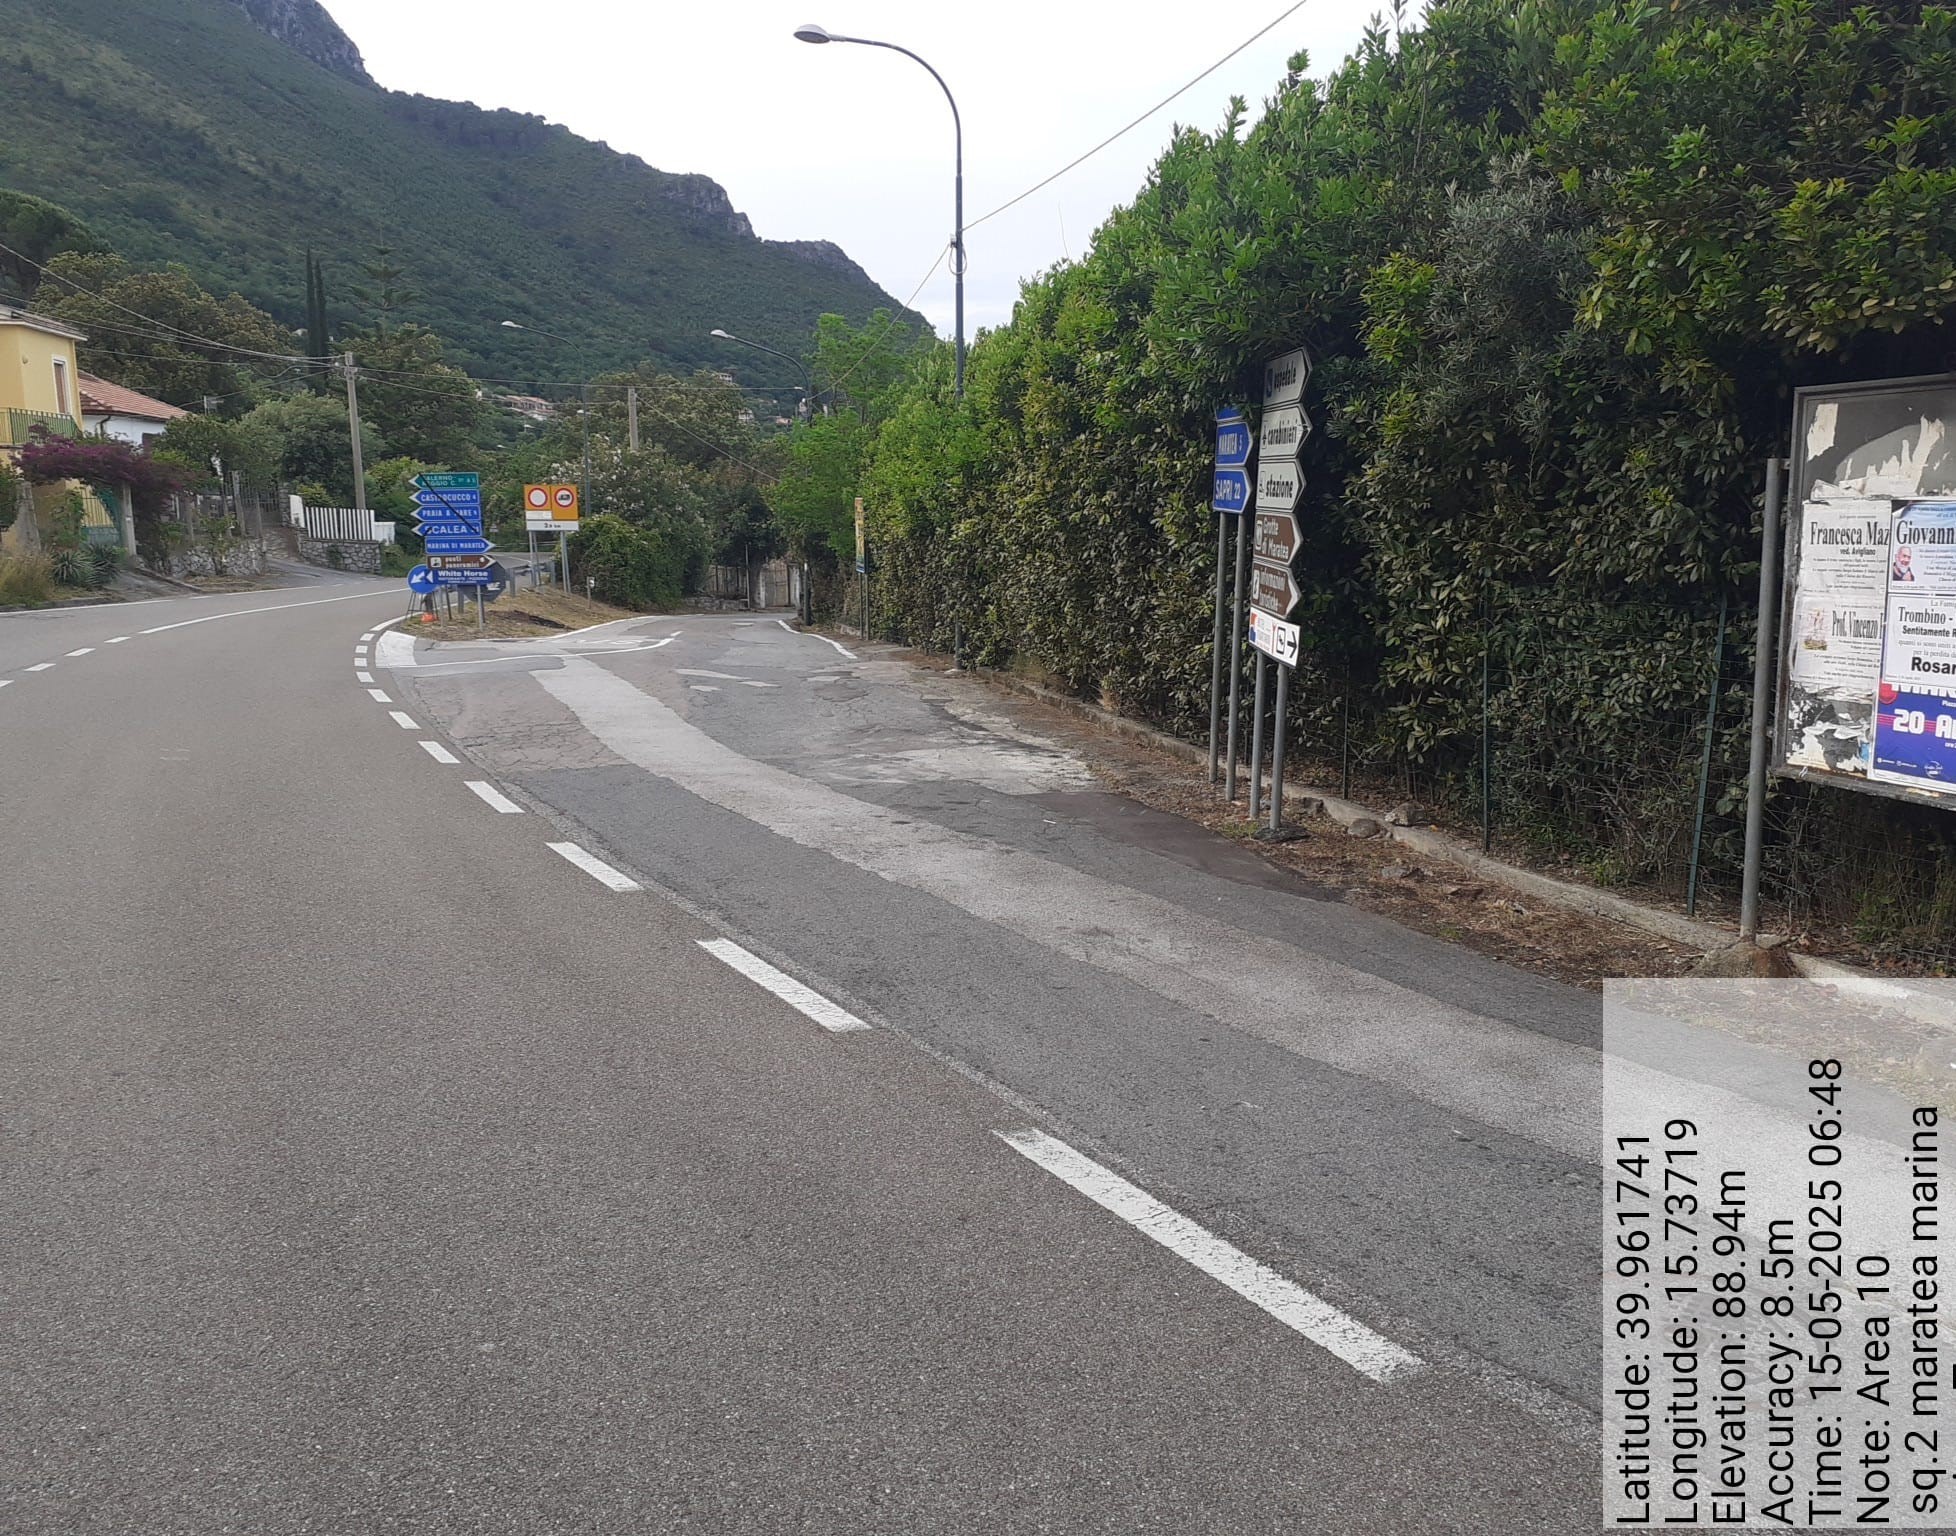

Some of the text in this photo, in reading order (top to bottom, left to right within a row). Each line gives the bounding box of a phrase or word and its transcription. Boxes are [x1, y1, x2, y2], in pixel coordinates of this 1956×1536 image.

[1274, 359, 1296, 392] ospedale
[1267, 418, 1297, 446] carabinieri
[1218, 433, 1237, 455] MARATEA
[1215, 479, 1241, 500] SAPRI 22
[1265, 473, 1294, 499] stazione
[422, 509, 443, 517] PRAIA
[424, 524, 468, 535] SCALEA
[1263, 515, 1279, 536] Grotte
[1809, 521, 1863, 546] Francesca
[1267, 537, 1289, 560] Maratea
[1831, 610, 1848, 637] Prof.
[1848, 610, 1879, 640] Vincenzo
[1897, 606, 1946, 625] Trombino
[1902, 625, 1950, 638] Sentitamente
[1893, 708, 1925, 735] 20
